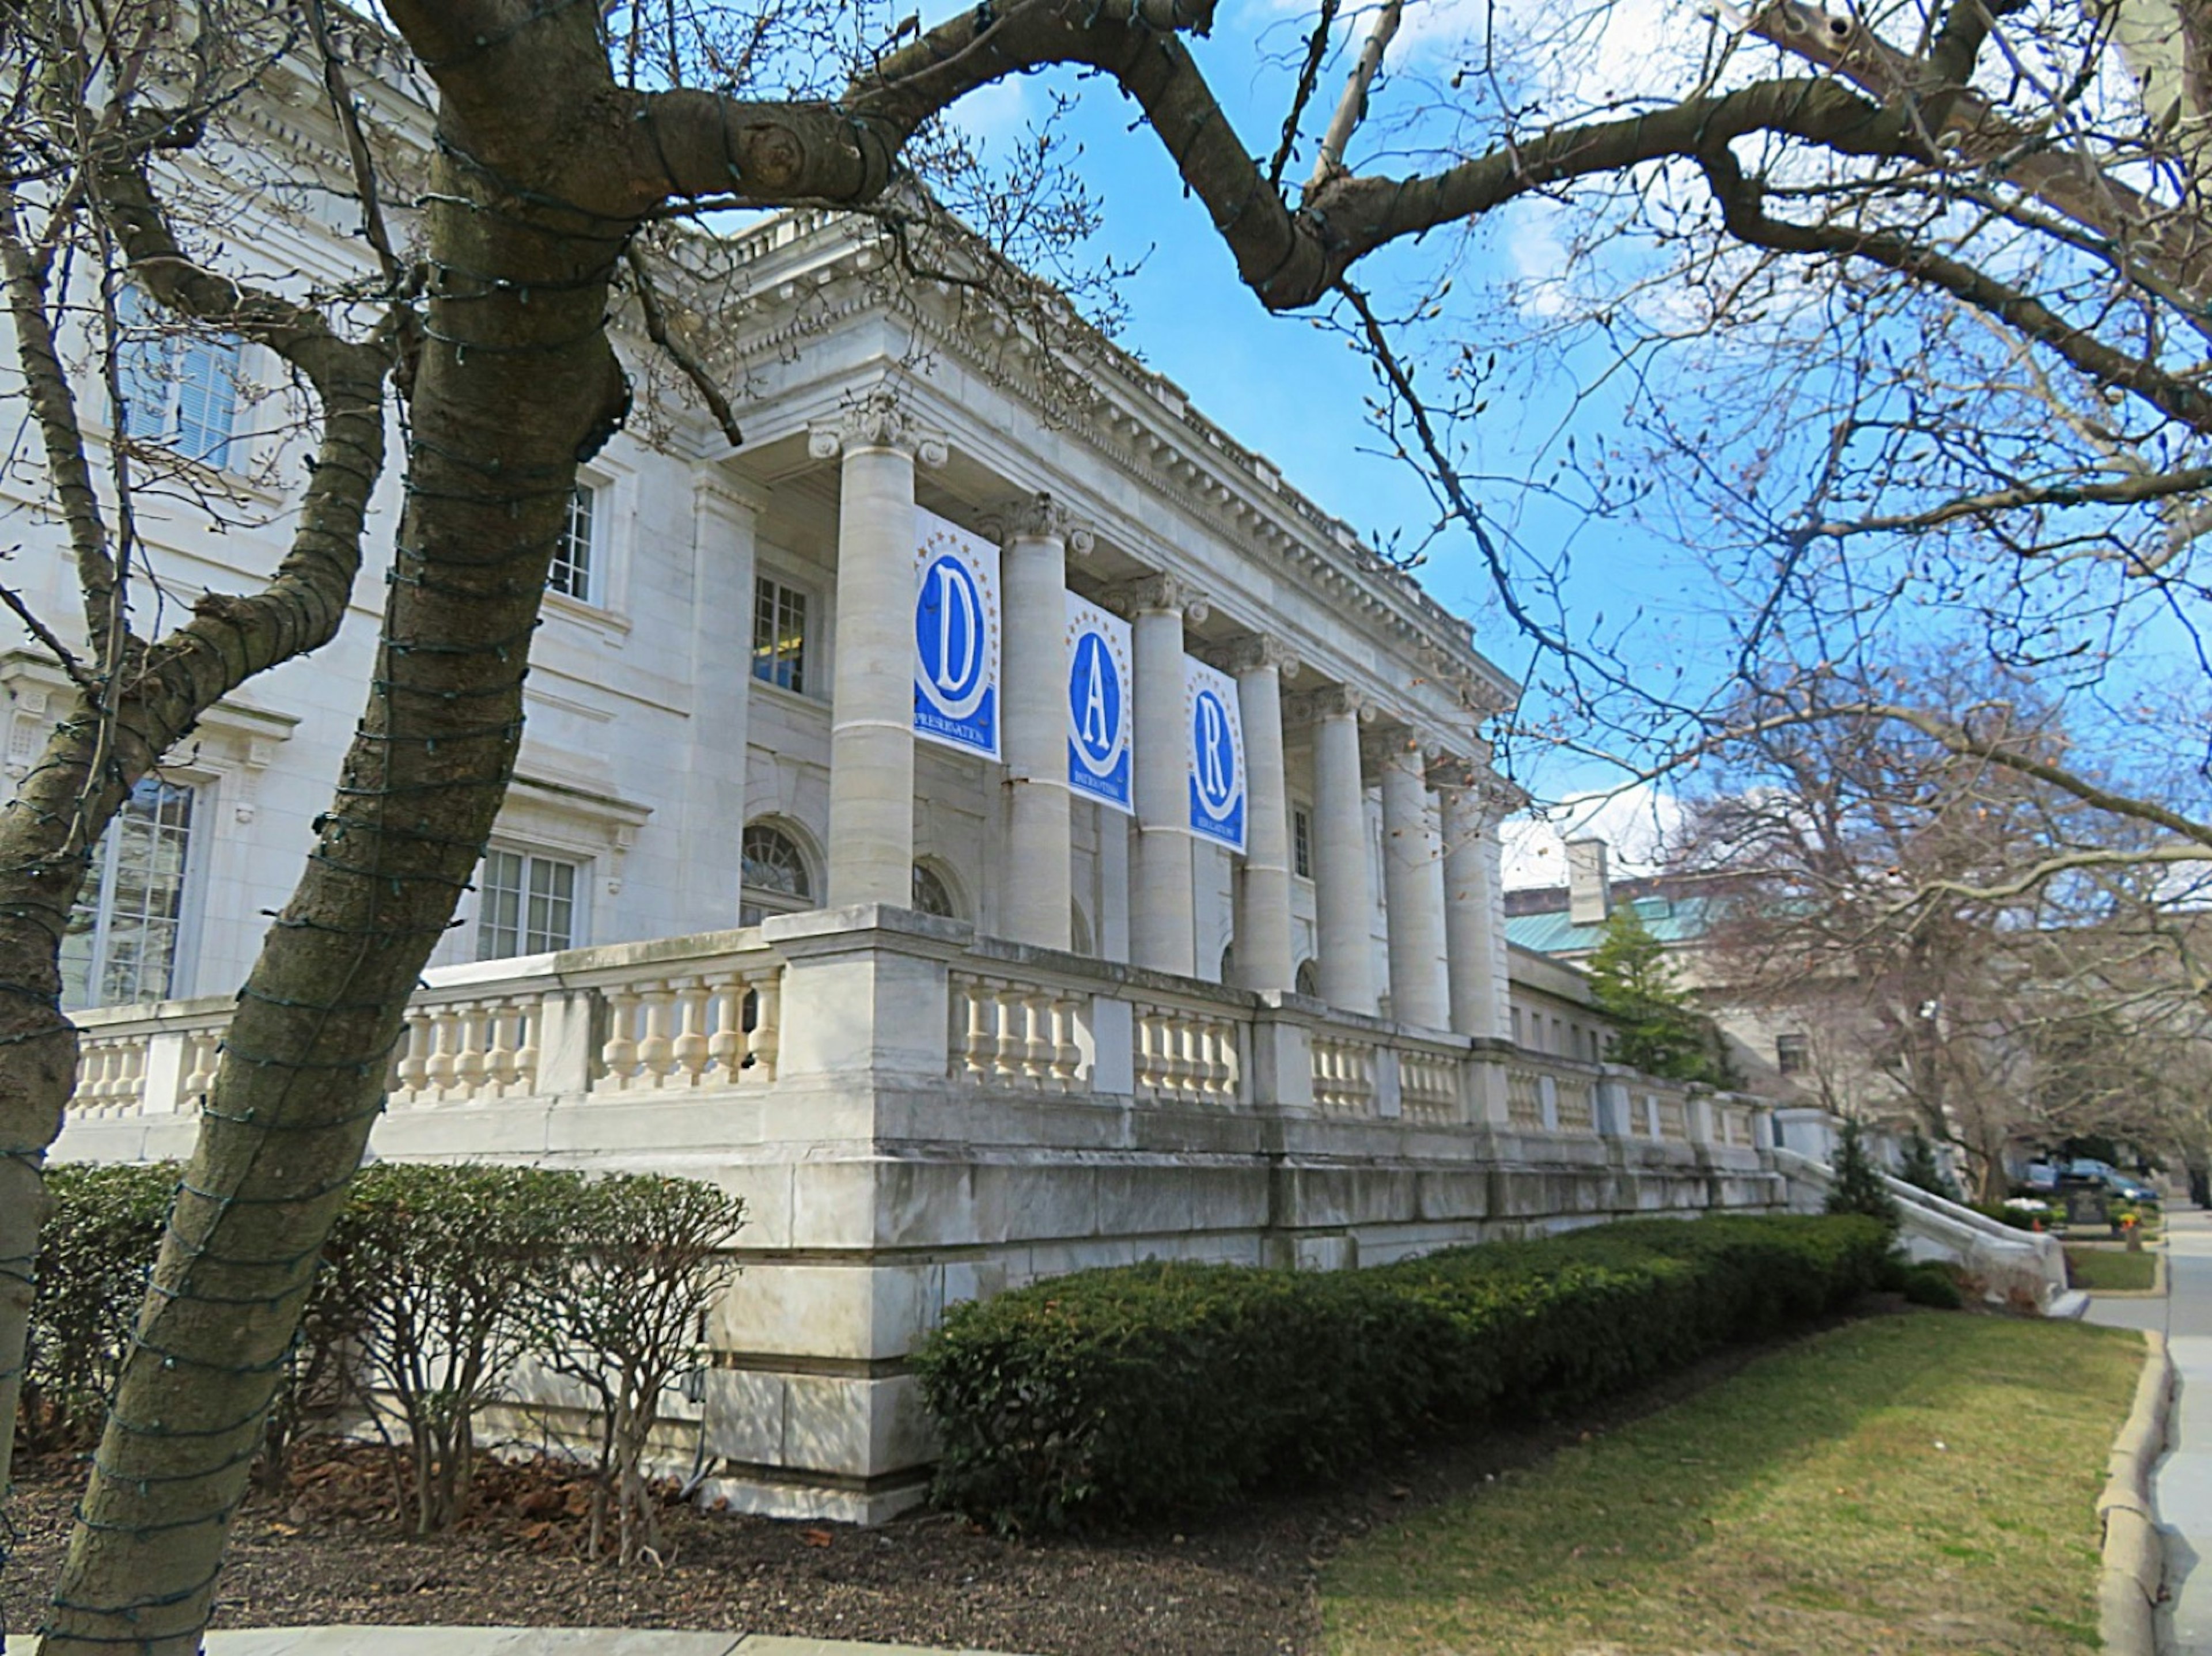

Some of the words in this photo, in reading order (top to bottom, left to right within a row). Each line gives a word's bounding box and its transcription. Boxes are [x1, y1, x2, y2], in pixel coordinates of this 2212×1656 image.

[937, 563, 975, 691] D
[1083, 636, 1109, 750] A
[1200, 695, 1227, 798] R
